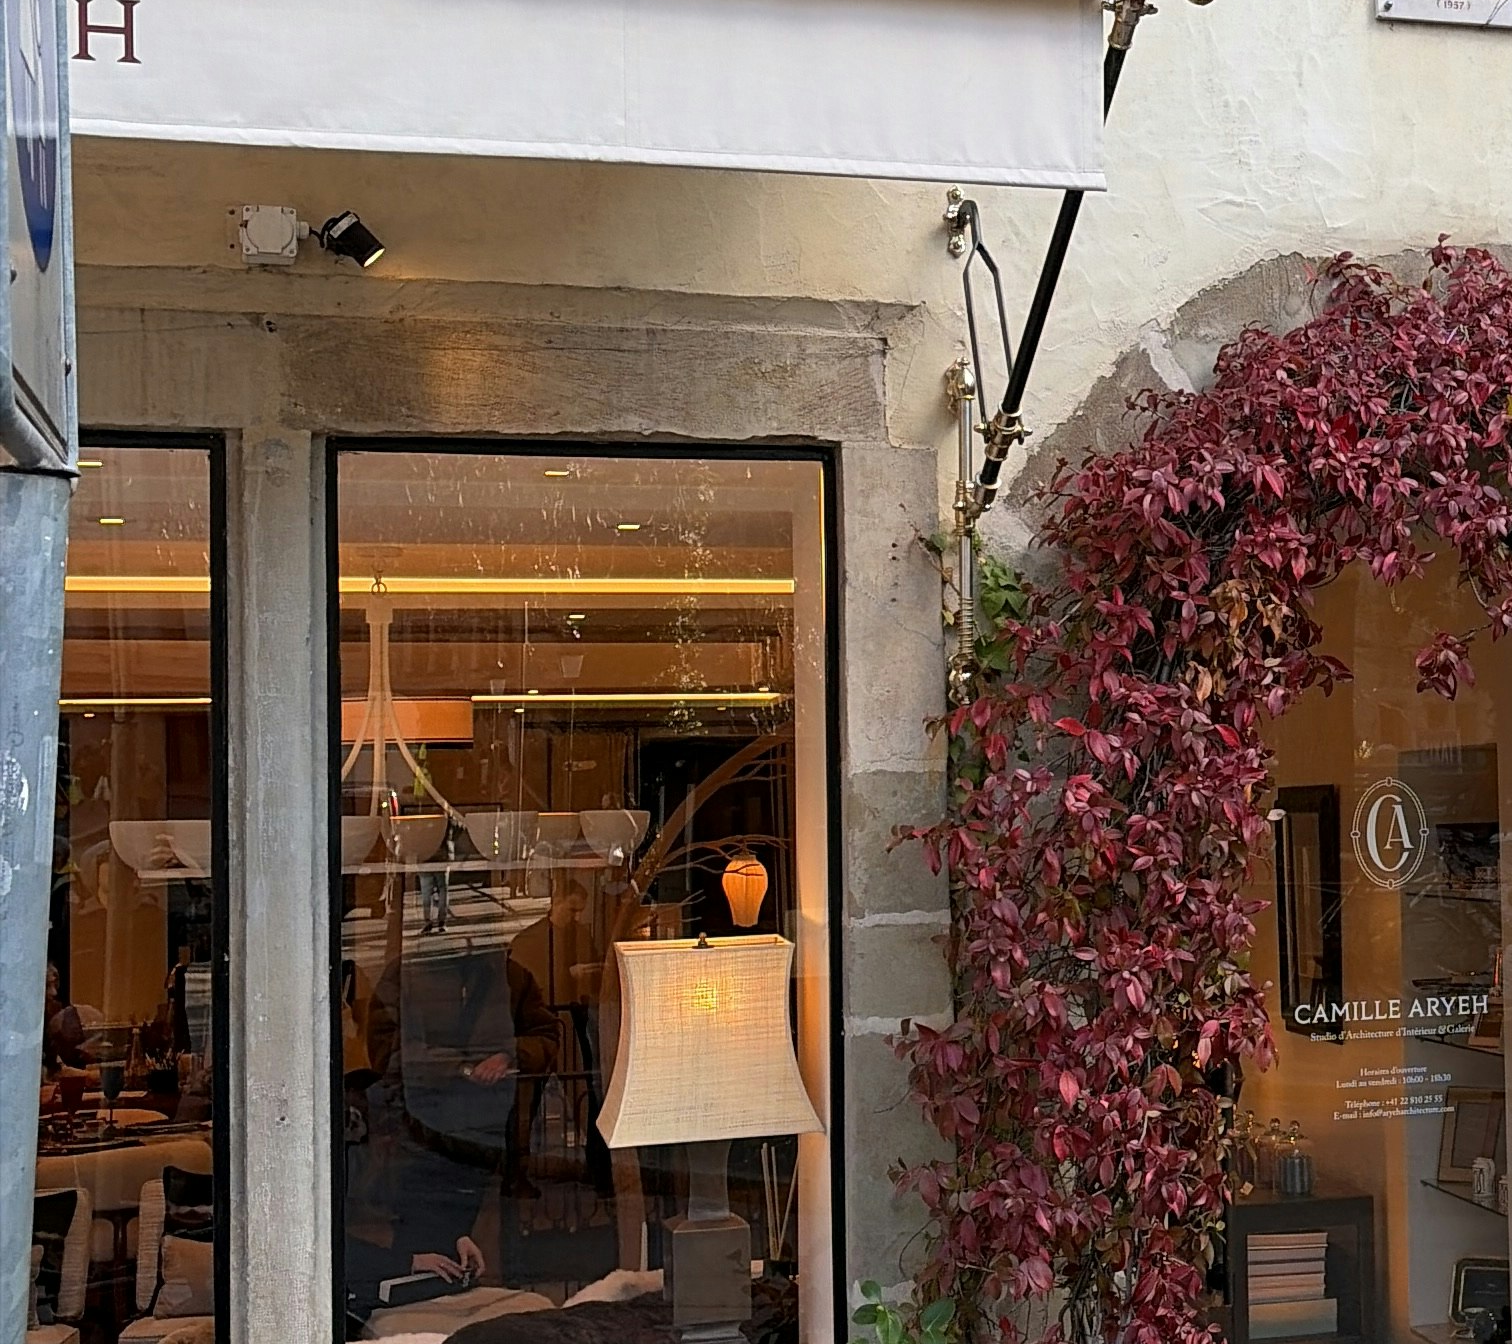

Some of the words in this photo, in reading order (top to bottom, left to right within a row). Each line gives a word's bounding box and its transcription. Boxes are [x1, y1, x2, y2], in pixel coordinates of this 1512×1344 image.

[1294, 999, 1401, 1025] CAMILLE
[1408, 994, 1488, 1019] ARYEH
[1310, 1031, 1337, 1042] Studio
[1400, 1097, 1409, 1105] 22
